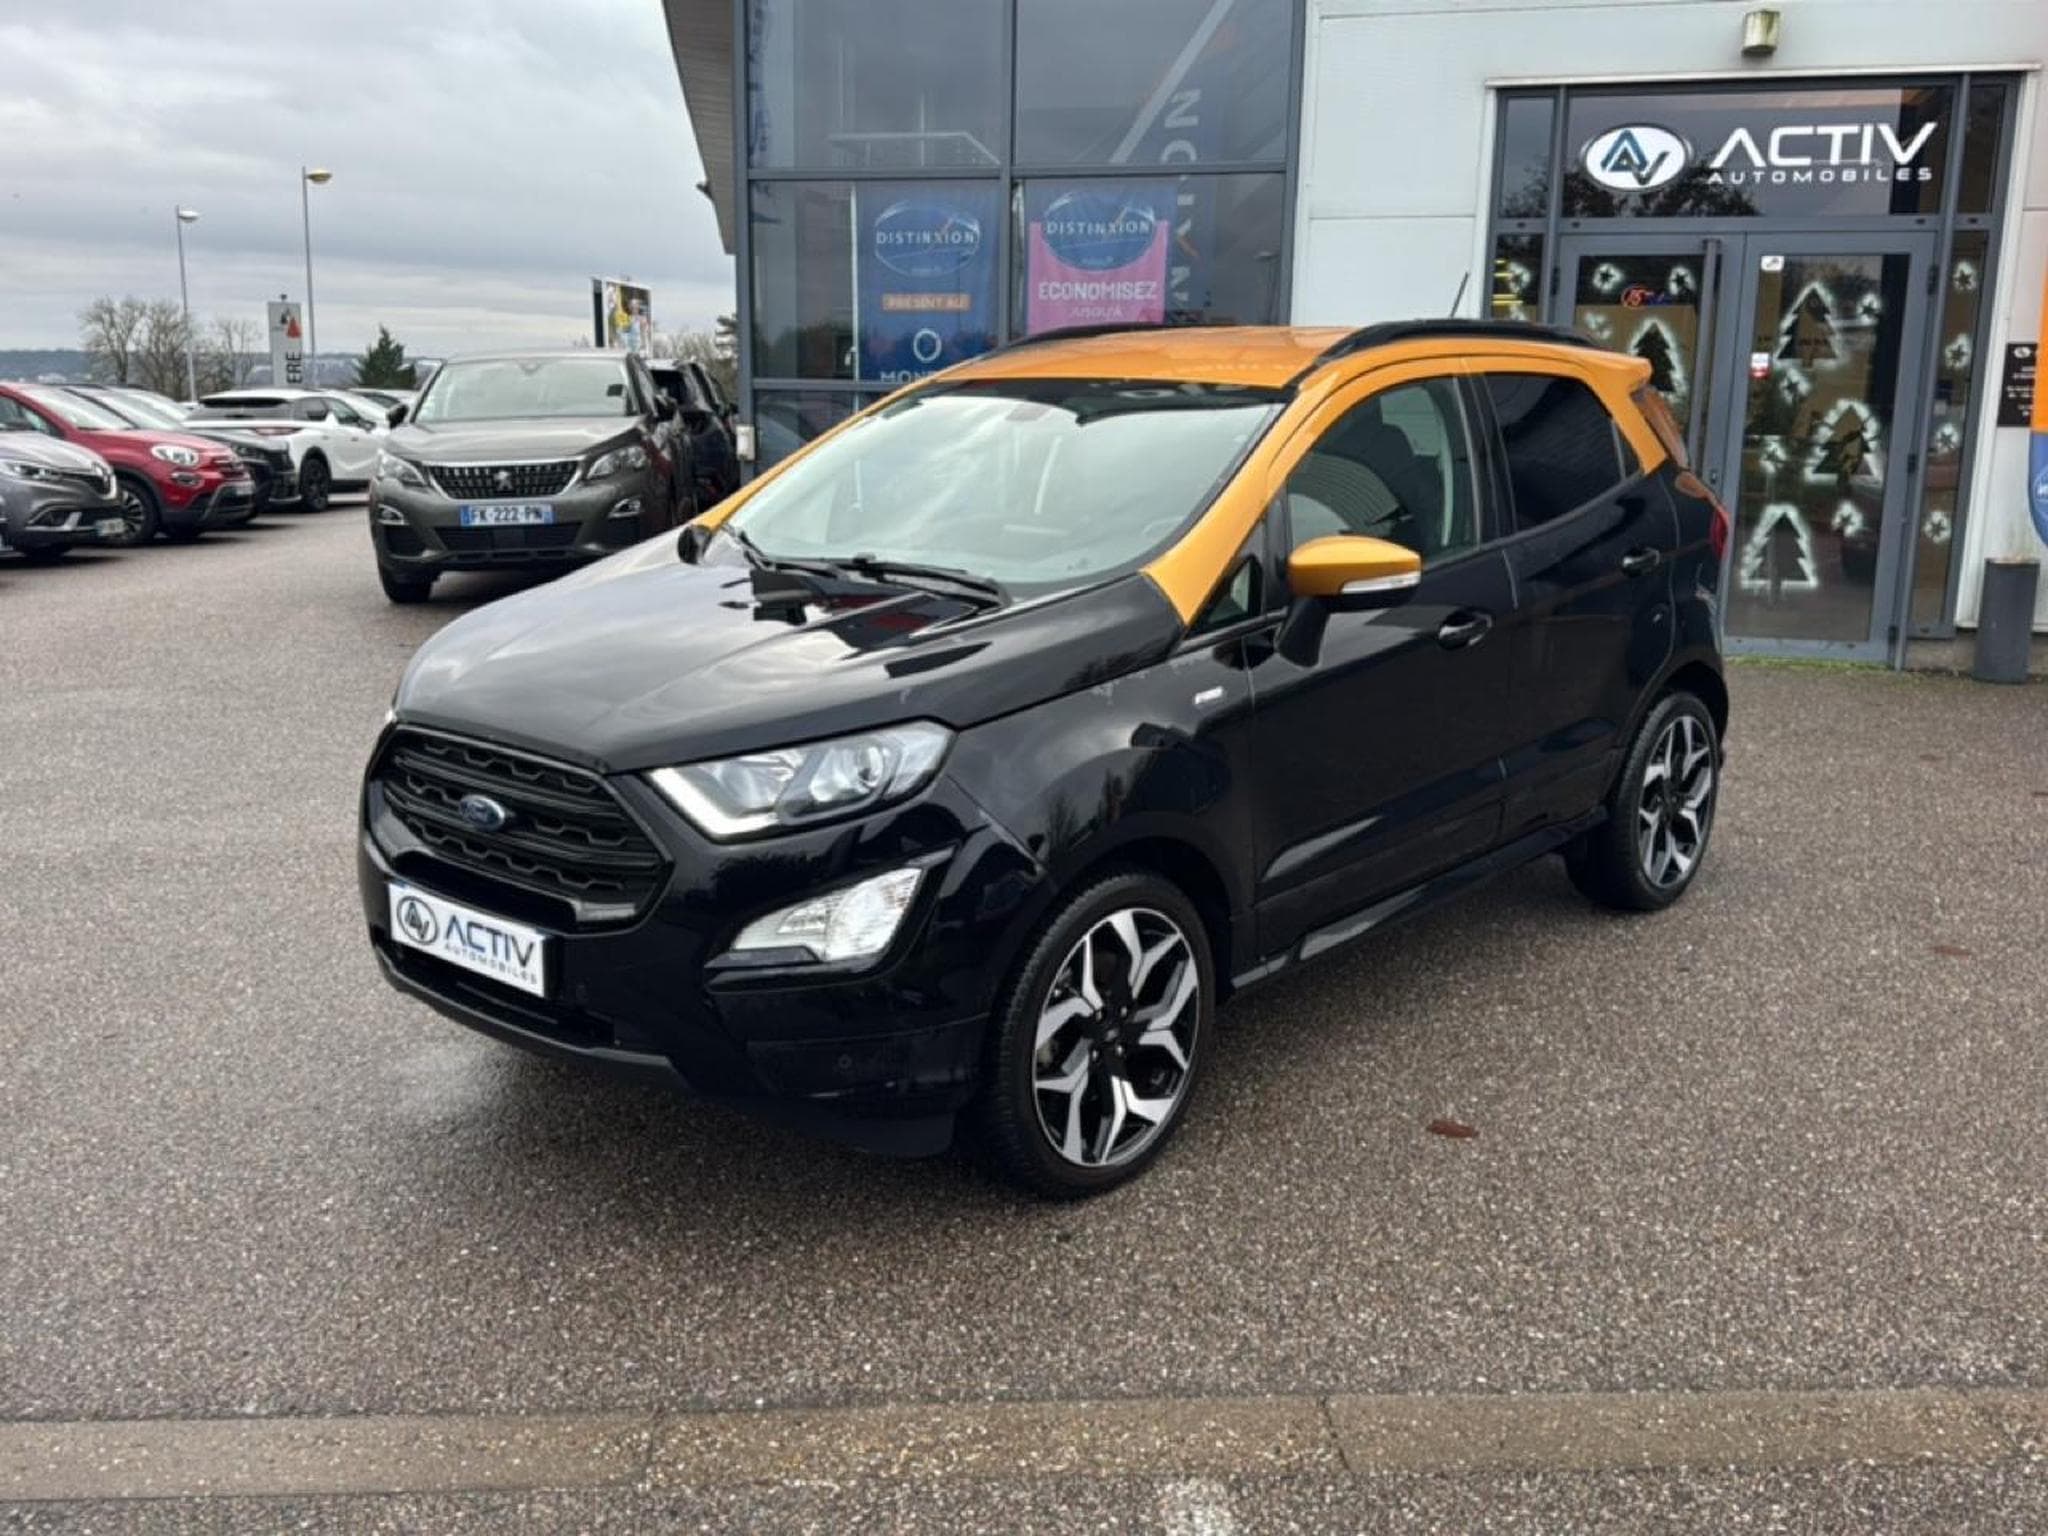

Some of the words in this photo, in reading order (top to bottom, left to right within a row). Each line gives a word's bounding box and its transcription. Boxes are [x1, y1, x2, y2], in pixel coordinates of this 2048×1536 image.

[1709, 122, 1938, 169] ACTIV
[1706, 166, 1933, 185] AUTOMOBILES
[875, 229, 975, 245] DISTINXION
[445, 914, 535, 968] ACTIV
